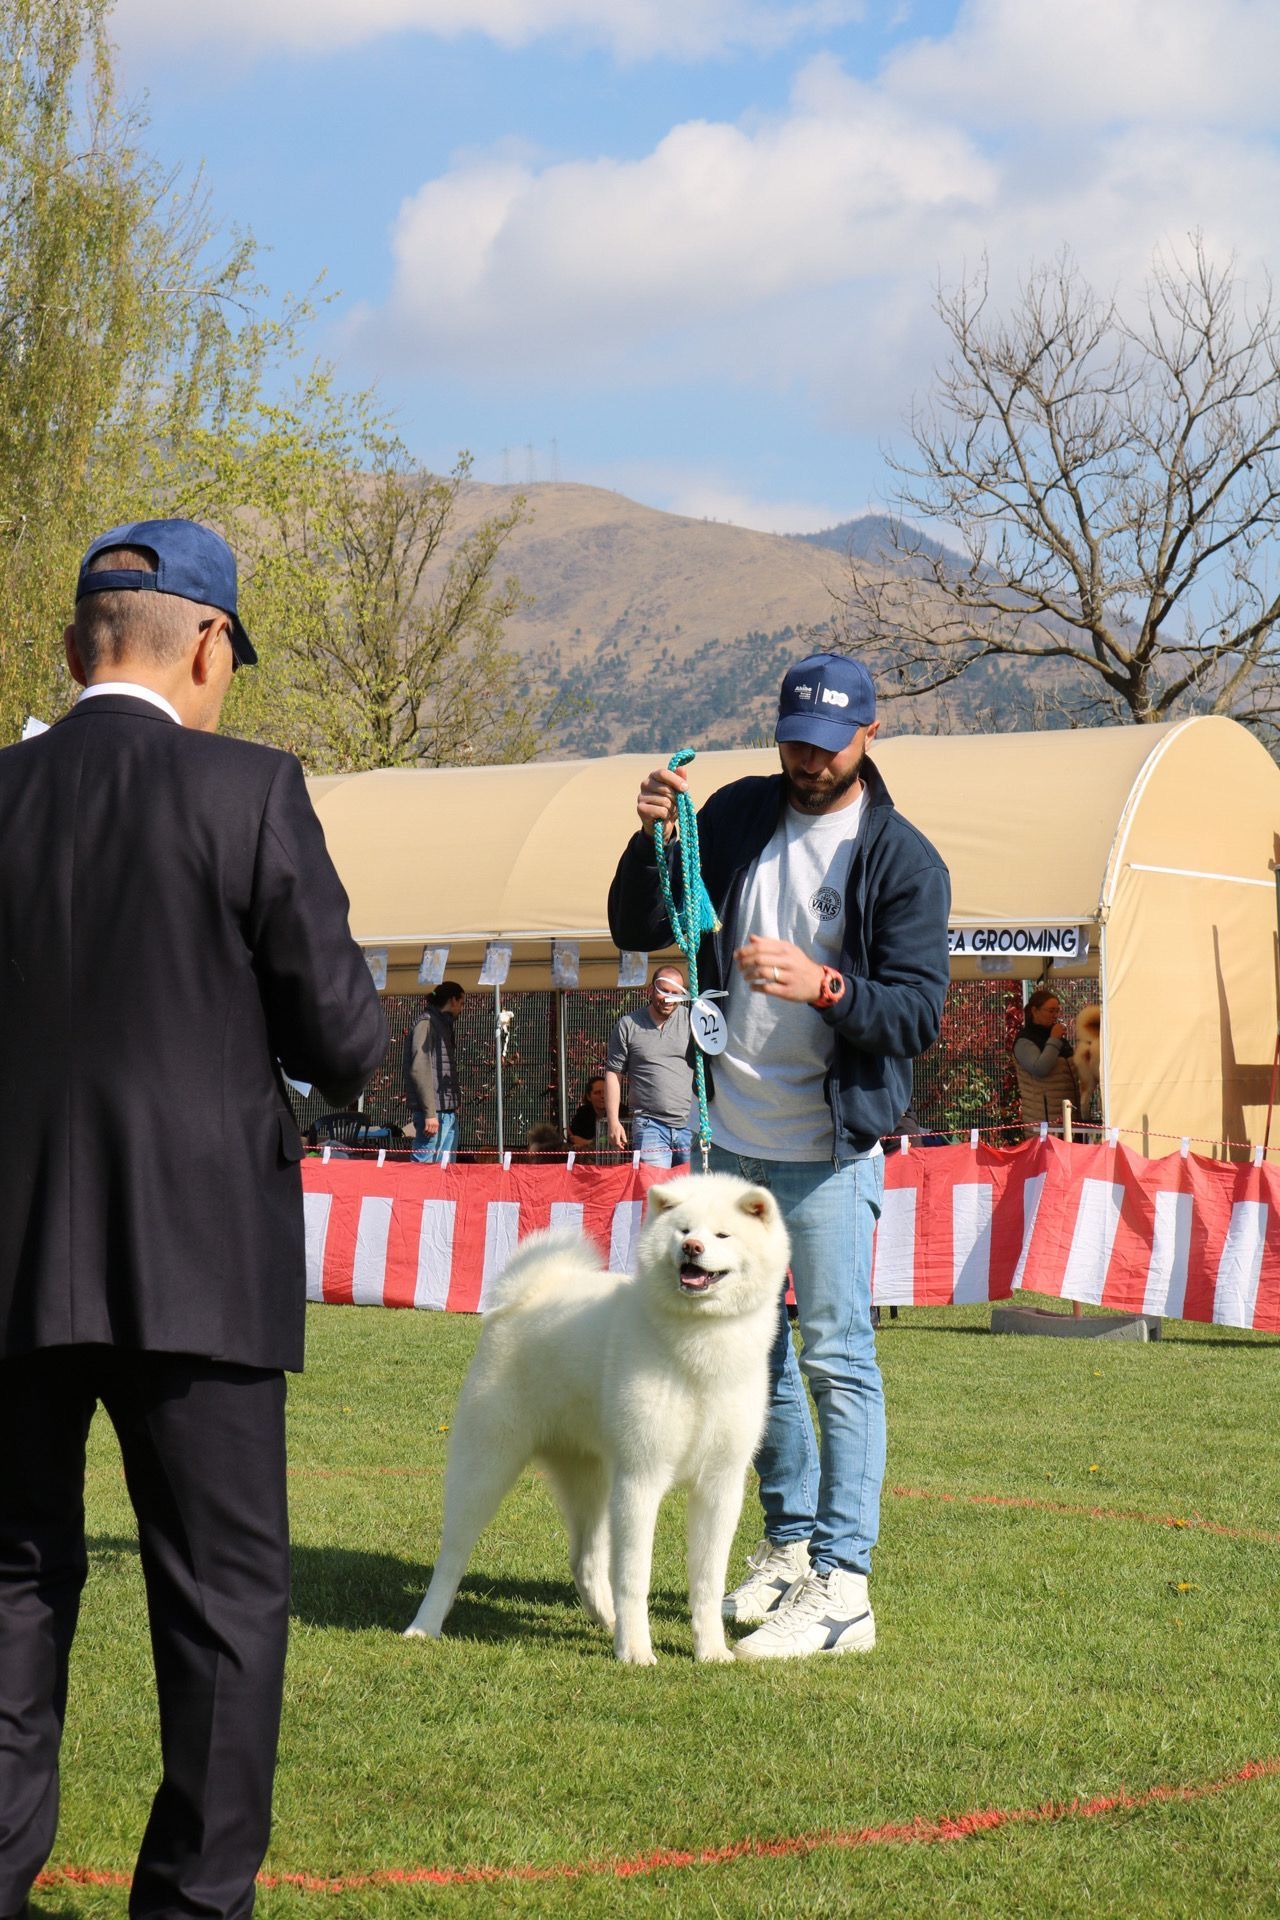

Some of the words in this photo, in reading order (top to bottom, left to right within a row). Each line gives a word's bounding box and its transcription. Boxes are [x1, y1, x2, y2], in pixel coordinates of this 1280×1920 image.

[812, 899, 837, 915] VANS
[972, 929, 1076, 952] GROOMING
[700, 1014, 720, 1036] 22
